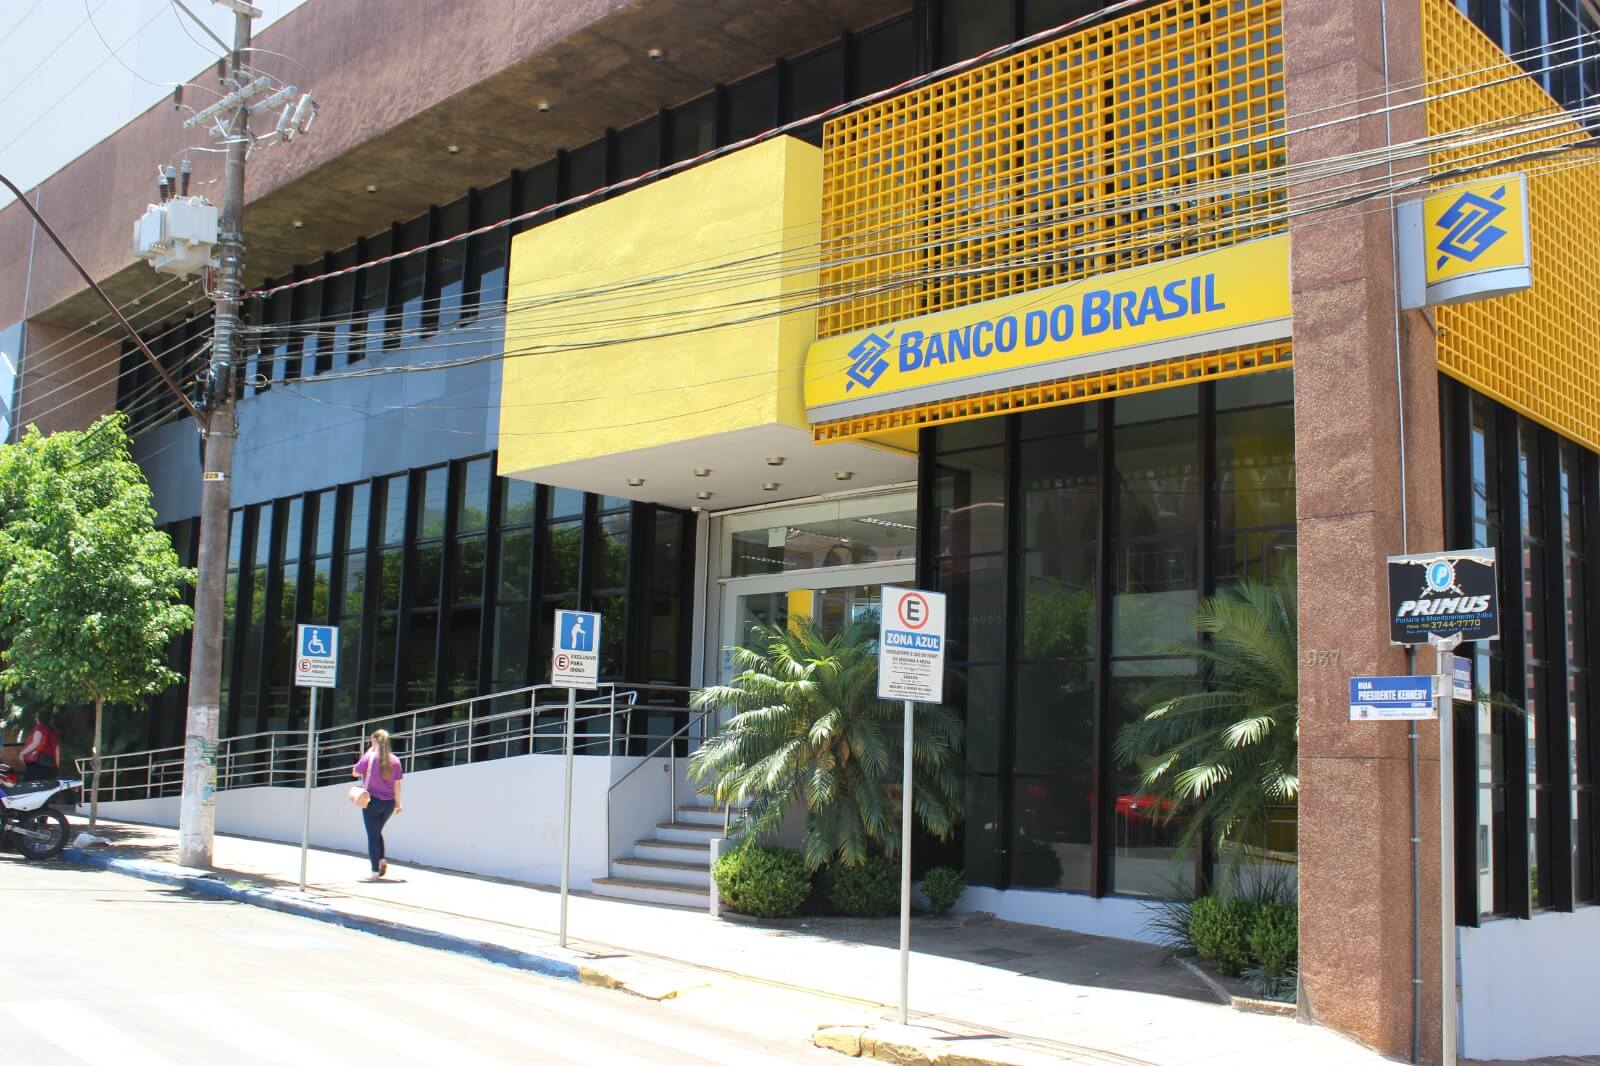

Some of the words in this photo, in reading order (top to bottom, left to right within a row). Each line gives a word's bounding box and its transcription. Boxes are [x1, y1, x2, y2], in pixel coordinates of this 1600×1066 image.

[899, 316, 1018, 373] BANCO
[1024, 304, 1074, 348] DO
[1081, 273, 1226, 336] BRASIL
[907, 600, 920, 621] E
[1397, 594, 1492, 617] PRIMUS
[1431, 618, 1481, 629] 3744-7770
[886, 632, 914, 646] ZONA
[914, 635, 939, 649] AZUL
[302, 661, 308, 670] E
[558, 657, 565, 667] E
[1358, 681, 1372, 690] RUA
[1358, 690, 1397, 701] PRESIDENTE
[1397, 688, 1428, 700] KENNEDY
